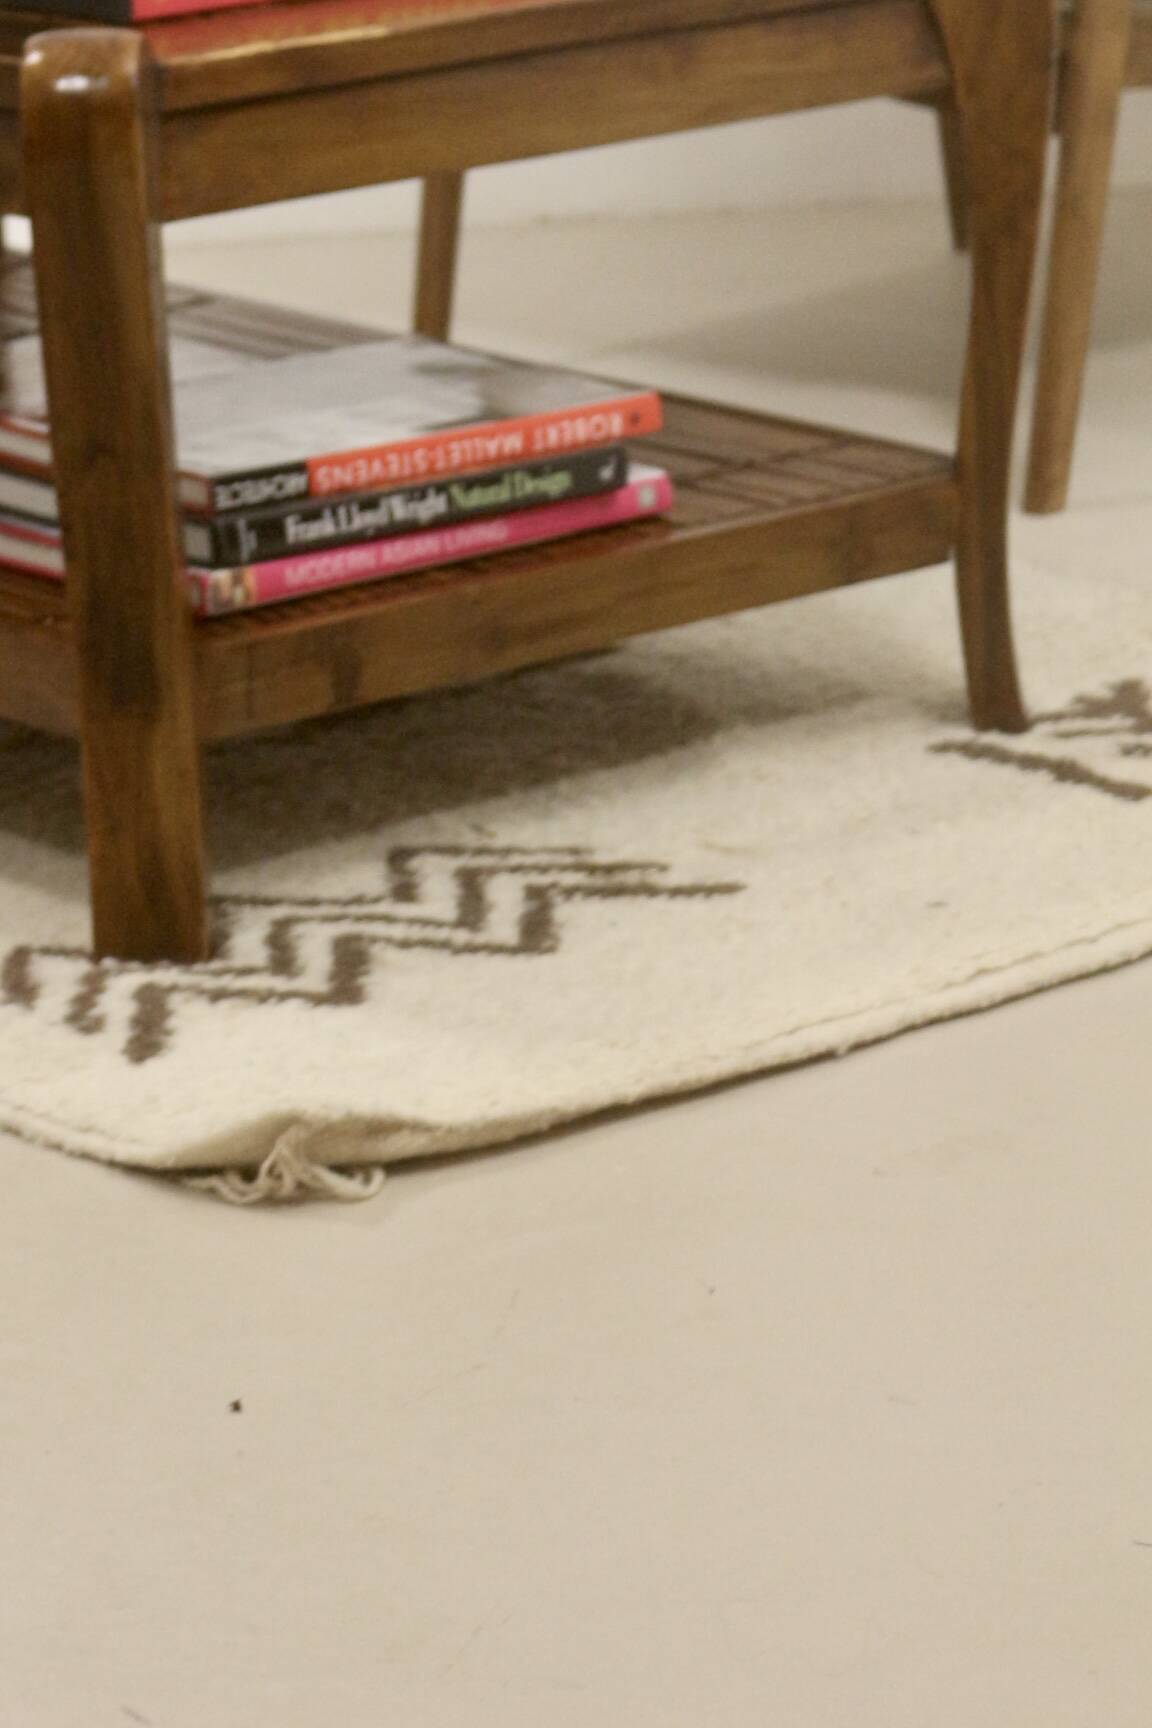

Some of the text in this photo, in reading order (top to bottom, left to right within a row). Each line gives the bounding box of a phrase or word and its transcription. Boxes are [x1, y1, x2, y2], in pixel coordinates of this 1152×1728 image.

[315, 411, 625, 496] ROBERT MALLET-STEVENS
[285, 505, 335, 544] Frank
[337, 496, 389, 535] Lloyd
[391, 486, 448, 525] Wright
[451, 472, 512, 509] Natural
[514, 471, 572, 499] Design
[284, 520, 508, 587] MODERN ASIAN LIVING
